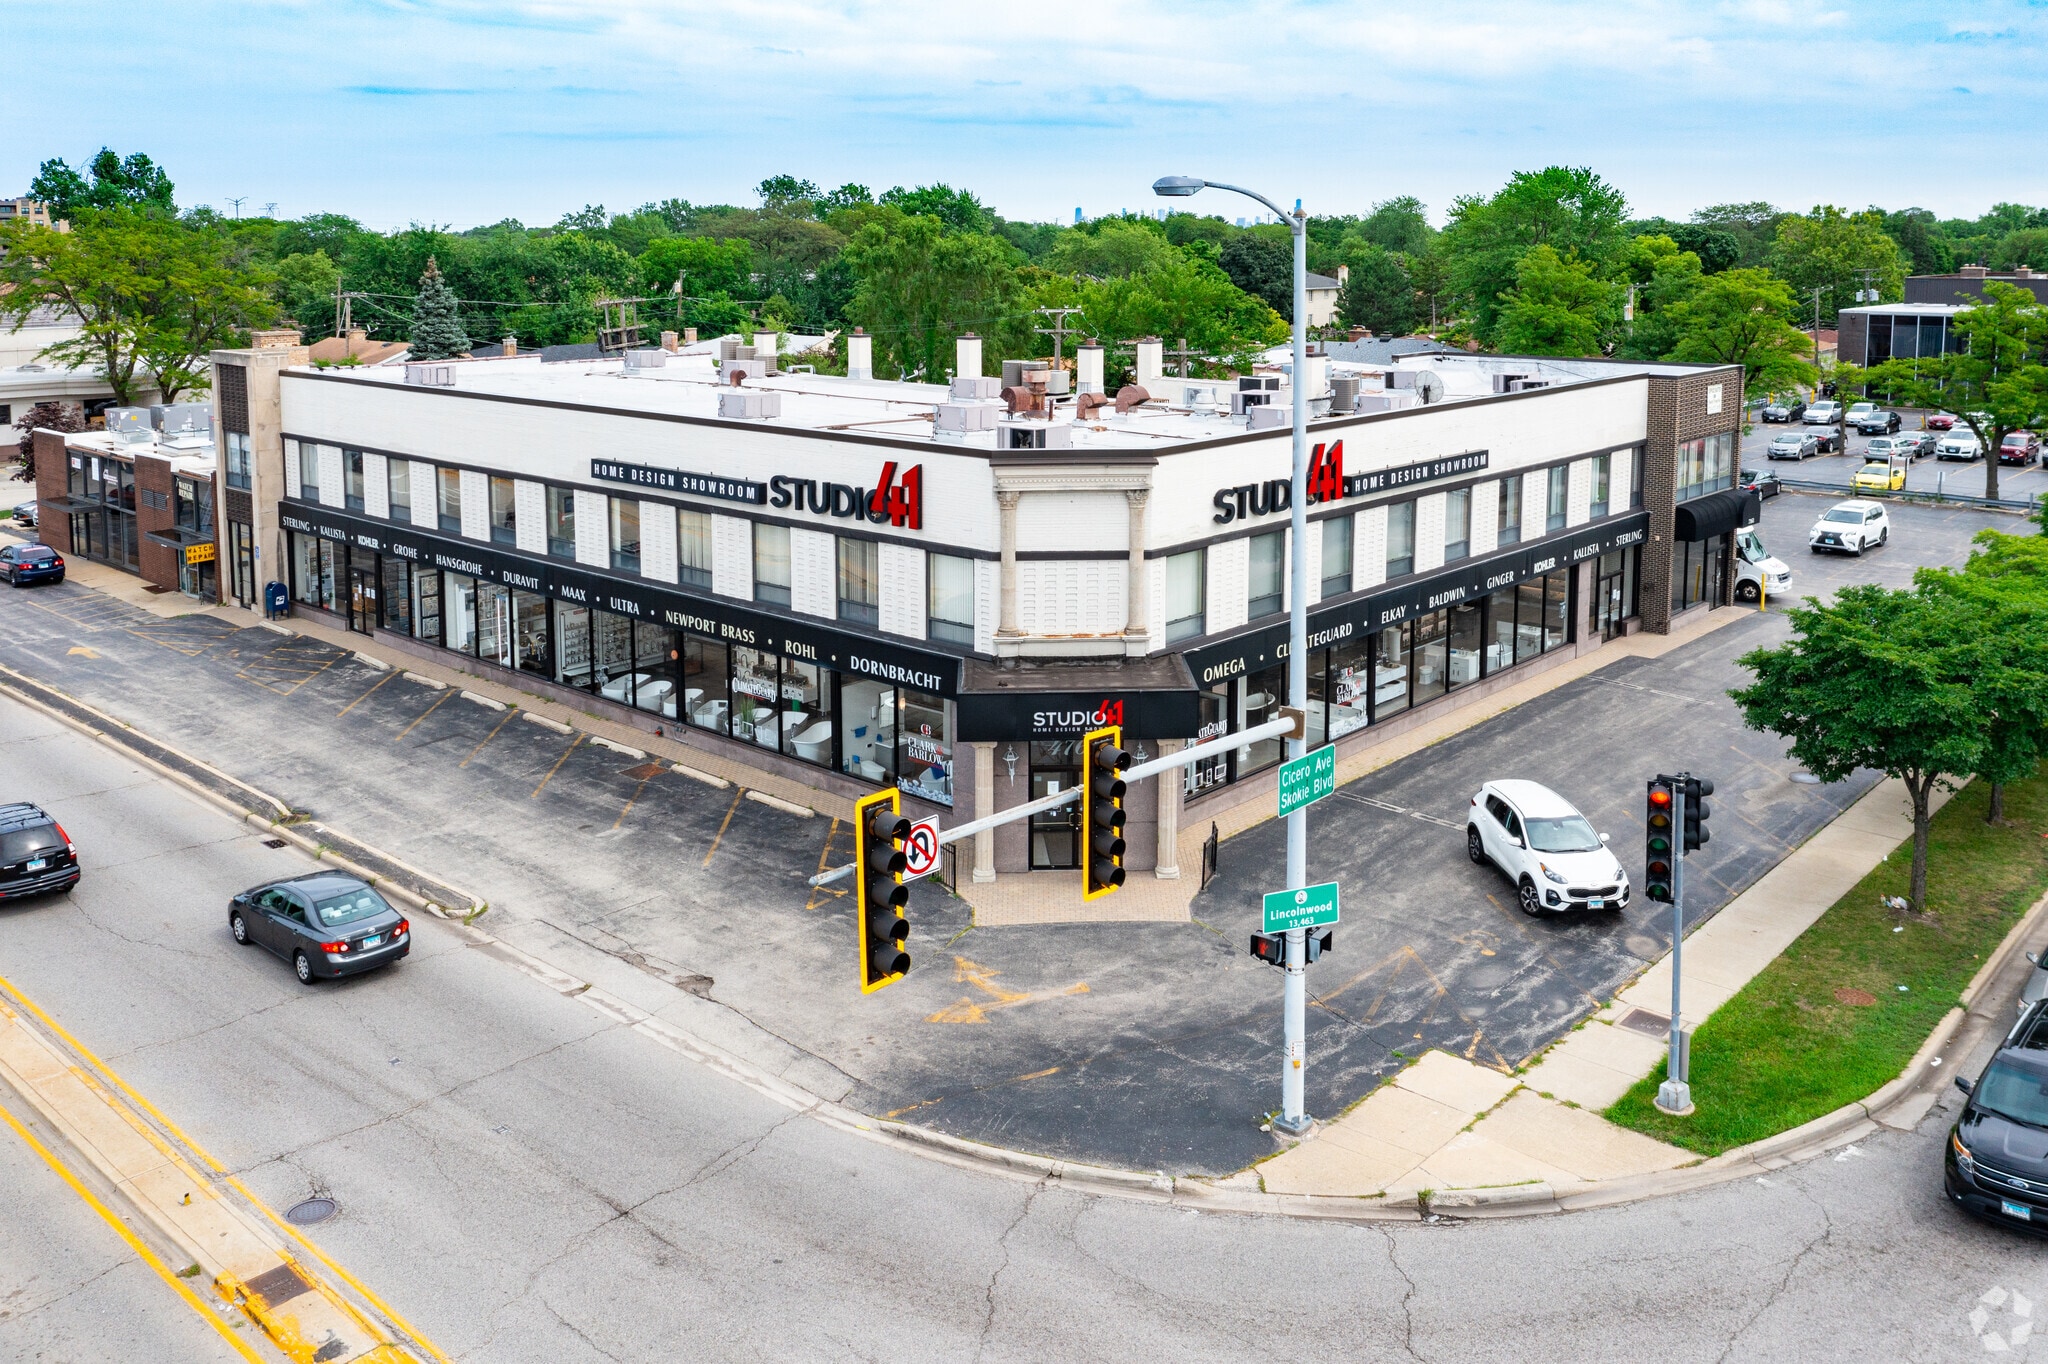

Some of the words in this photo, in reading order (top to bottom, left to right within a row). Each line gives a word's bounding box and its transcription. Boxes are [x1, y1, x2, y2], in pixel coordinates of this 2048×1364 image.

[594, 463, 624, 479] HOME
[631, 468, 675, 487] DESIGN
[682, 477, 756, 500] SHOWROOM
[1355, 477, 1384, 492] HOME
[1391, 466, 1428, 484] DESIGN
[1434, 454, 1487, 475] SHOWROOM
[283, 515, 310, 532] STERLING
[320, 525, 346, 540] KALLISTA
[357, 535, 379, 549] KOHLER
[393, 543, 418, 559] GROHE
[436, 554, 482, 576] HANSGROHE
[503, 571, 539, 589] DURAVIT
[561, 585, 586, 601] MAAX
[610, 596, 640, 615] ULTRA
[665, 610, 716, 634] NEWPORT
[721, 623, 755, 643] BRASS
[785, 640, 817, 660] ROHL
[850, 655, 942, 691] DORNBRACHT
[1203, 657, 1245, 683] OMEGA
[1276, 623, 1352, 659] CLITEGUARD
[1381, 605, 1407, 625] ELKAY
[1429, 586, 1465, 609] BALDWIN
[1487, 570, 1514, 589] GINGER
[1534, 557, 1556, 575] KOHLER
[1573, 542, 1599, 560] KALLISTA
[1616, 529, 1643, 547] STERLING
[908, 746, 943, 765] BARLOW
[1281, 765, 1310, 787] Cicero
[1315, 756, 1332, 773] Ave
[1281, 786, 1310, 809] Skokie
[1313, 772, 1333, 794] Blvd
[1270, 900, 1333, 920] Lincolnwood
[1289, 917, 1315, 929] 13,463
